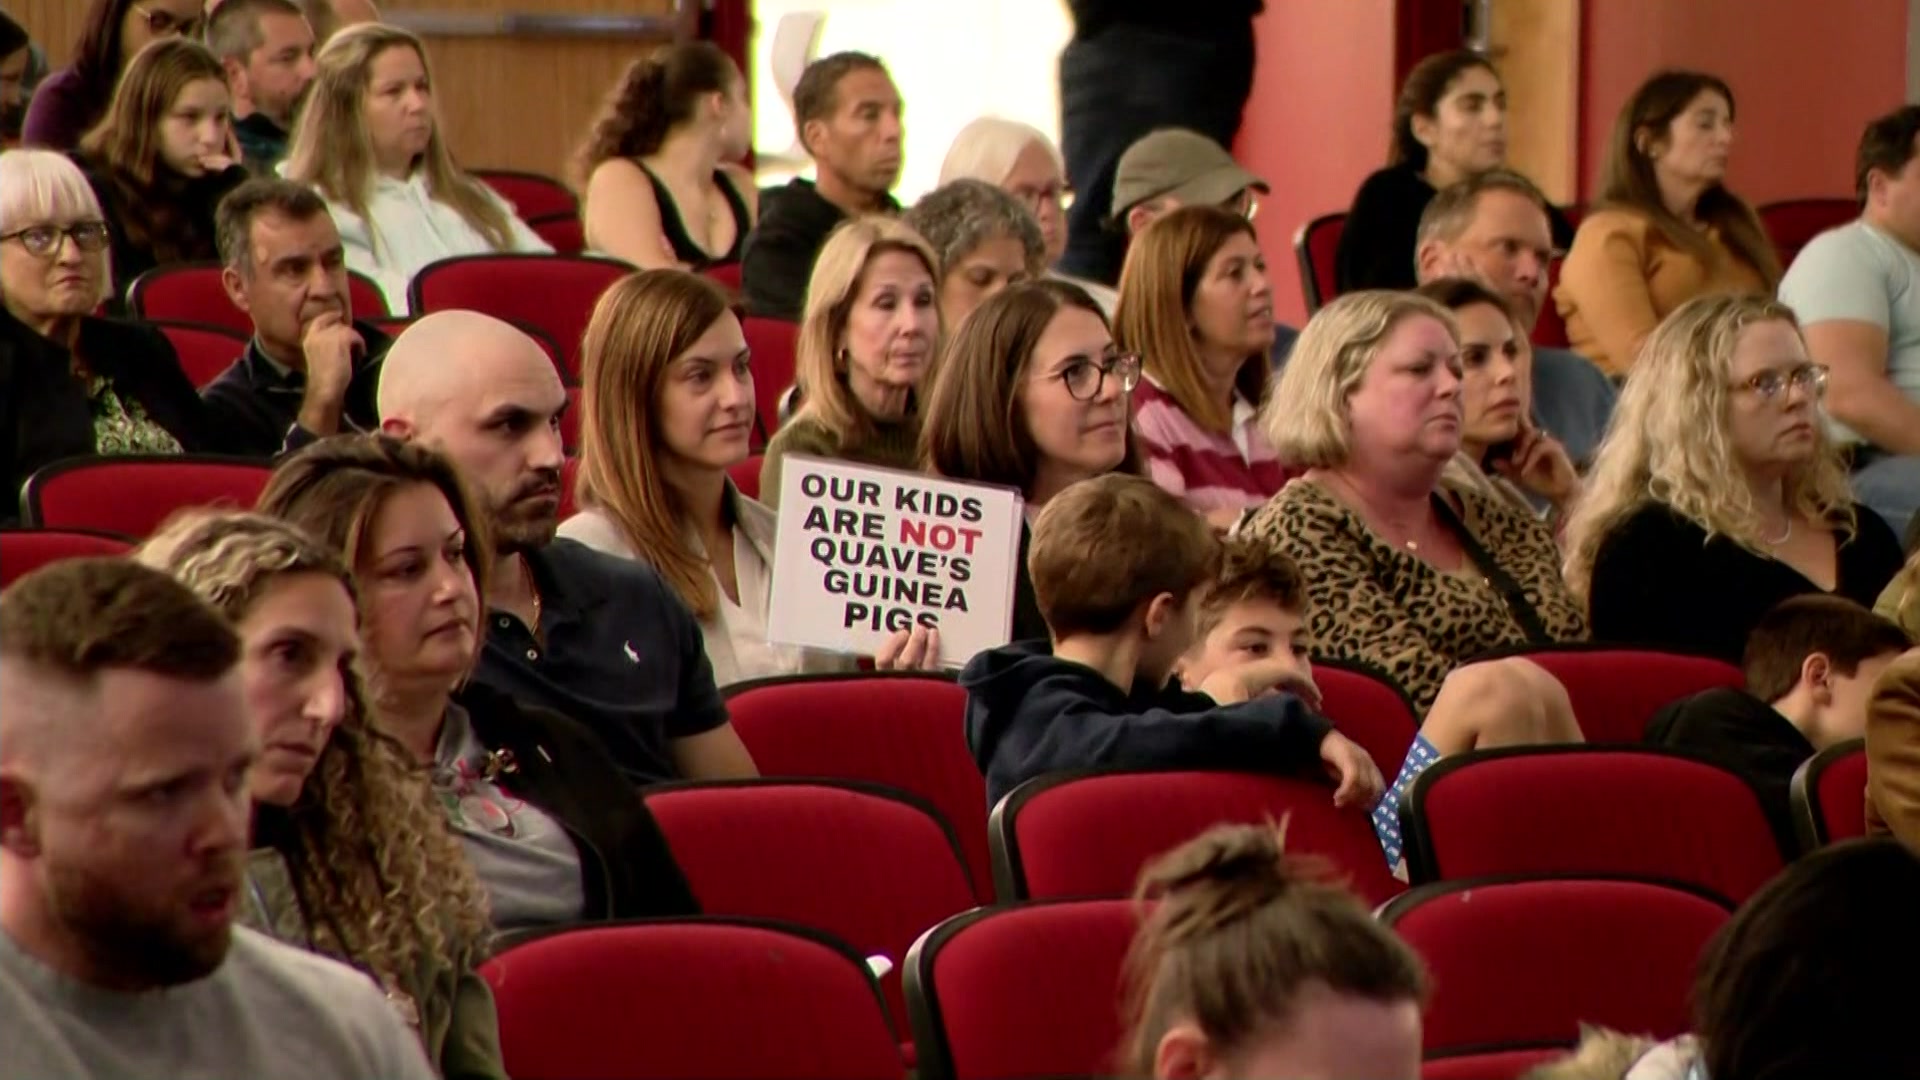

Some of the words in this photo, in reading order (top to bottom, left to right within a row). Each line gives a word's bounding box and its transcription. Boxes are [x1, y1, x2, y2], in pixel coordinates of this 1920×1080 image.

[801, 473, 881, 507] OUR
[895, 486, 983, 522] KIDS
[803, 505, 885, 540] ARE
[899, 518, 983, 555] NOT
[810, 537, 971, 582] QUAVE'S
[824, 569, 968, 612] GUINEA
